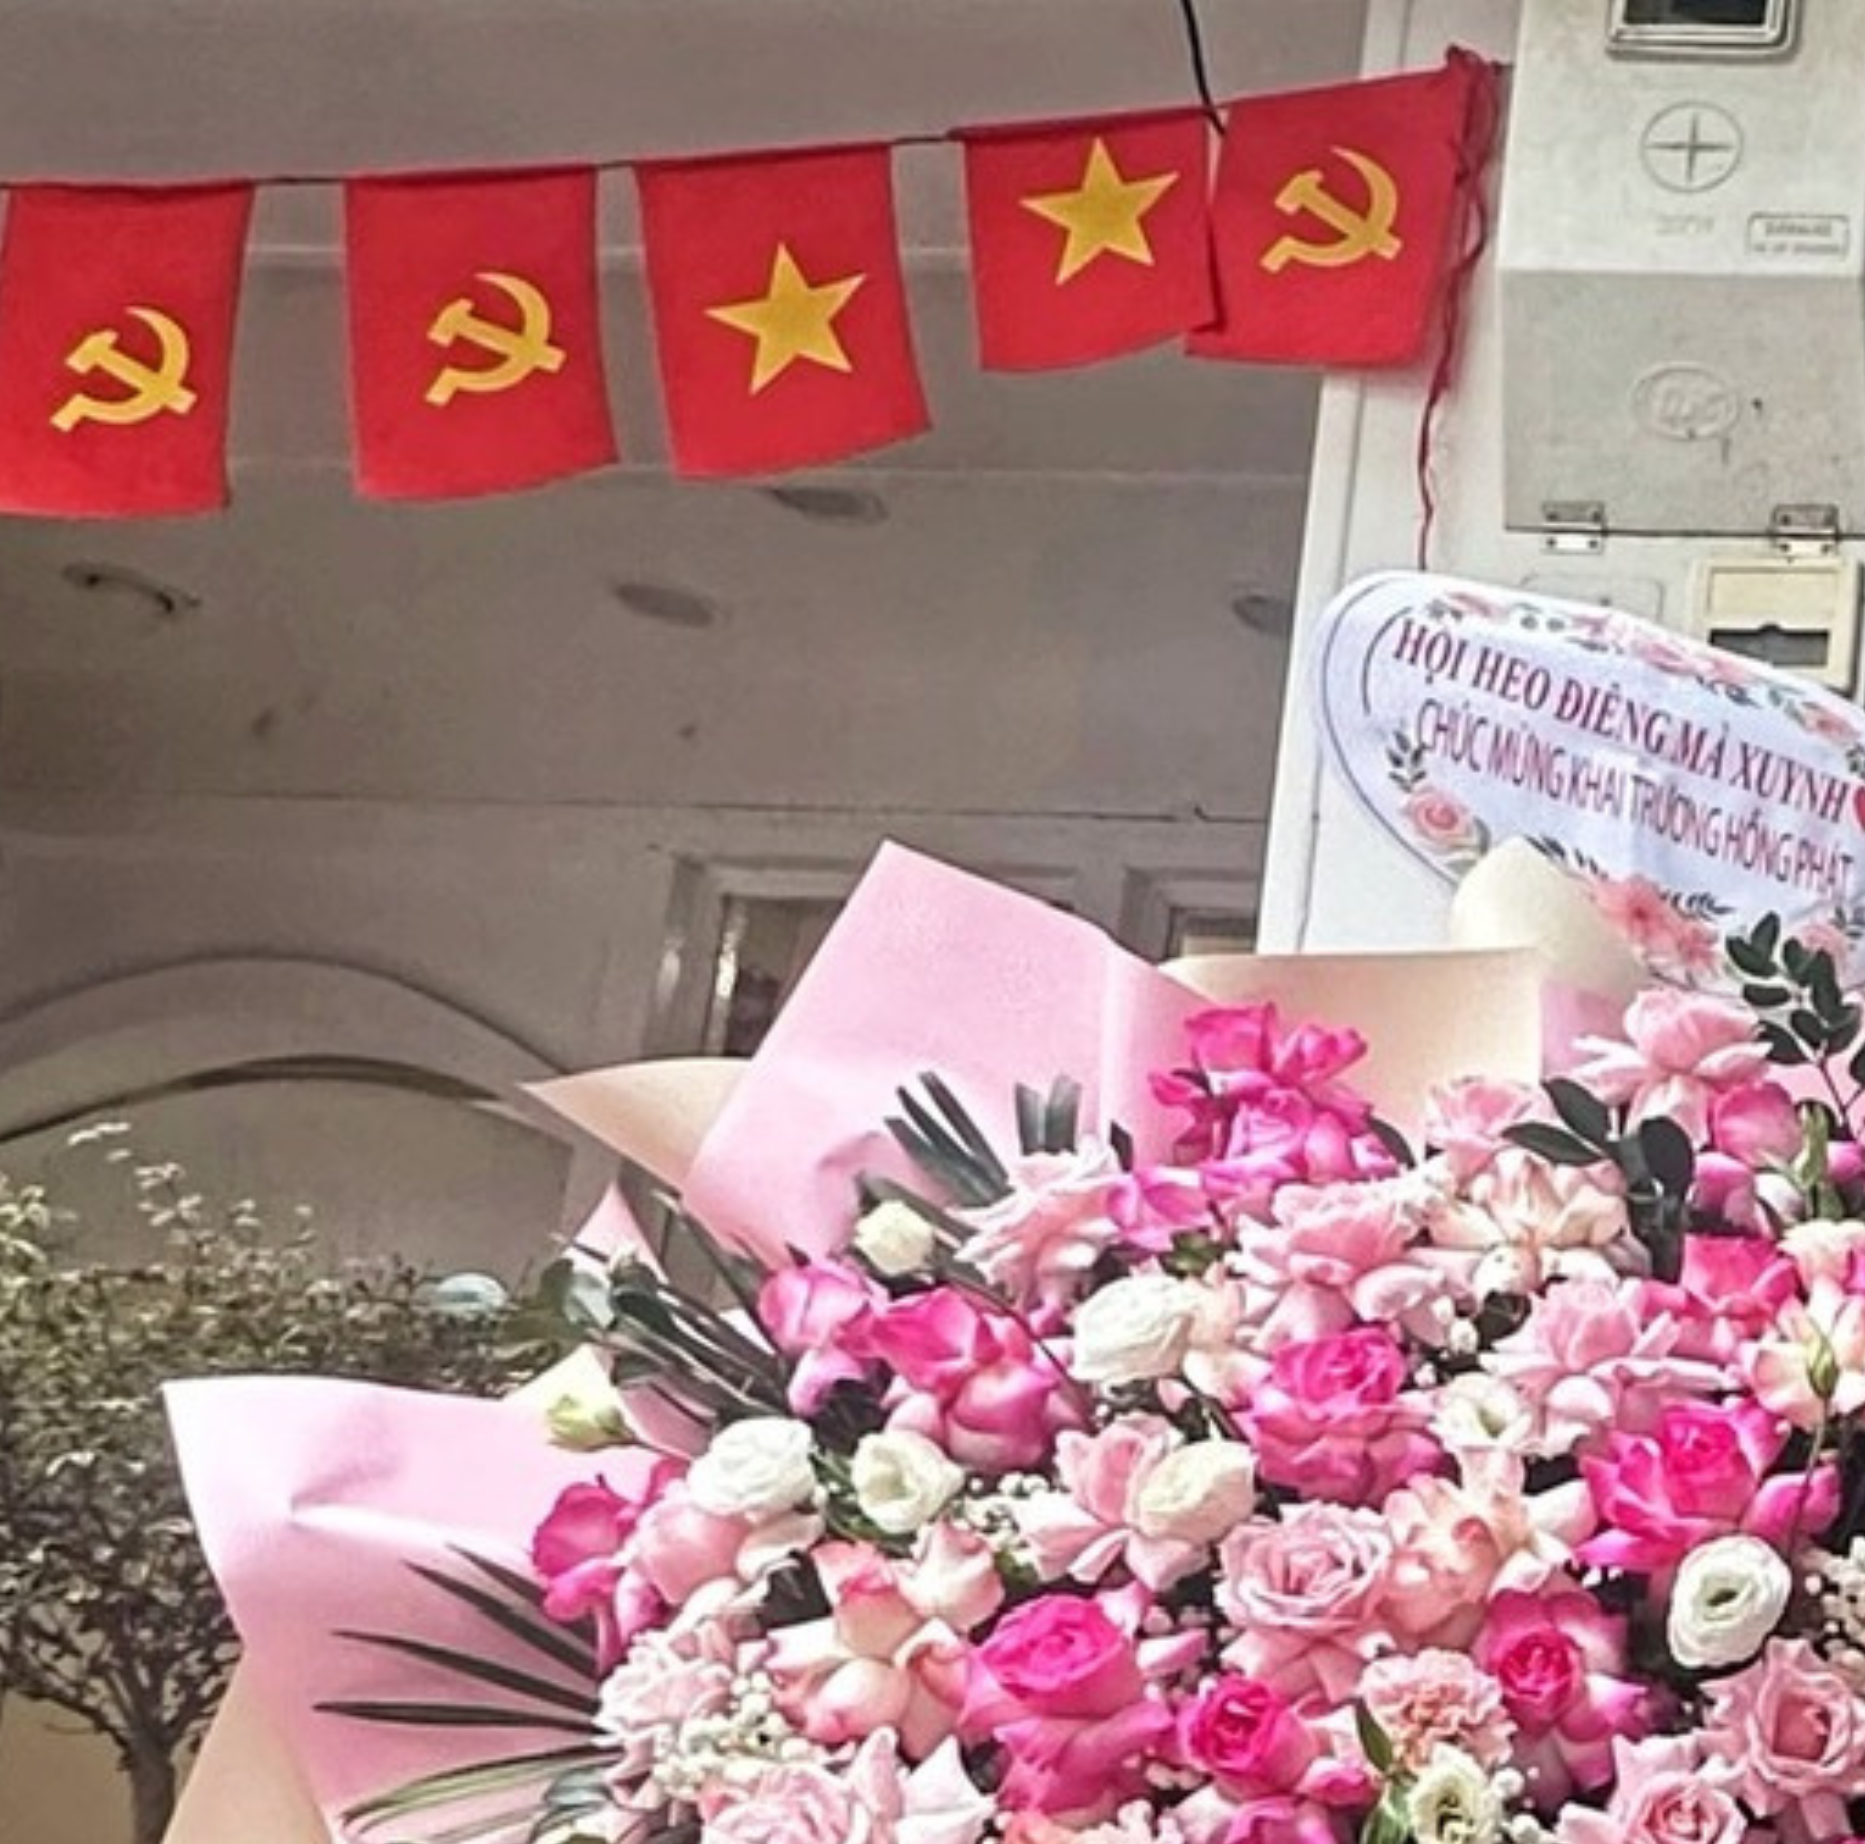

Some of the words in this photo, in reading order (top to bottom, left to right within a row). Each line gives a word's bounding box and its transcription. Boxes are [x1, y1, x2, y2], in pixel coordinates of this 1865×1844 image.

[1417, 697, 1489, 773] CHÚC
[1489, 721, 1566, 799] MỪNG
[1566, 753, 1626, 818] KHAI
[1631, 773, 1722, 857] TRƯƠNG
[1795, 837, 1855, 898] PHÁT
[1472, 645, 1551, 711] HEO
[1730, 741, 1850, 823] XUYNH
